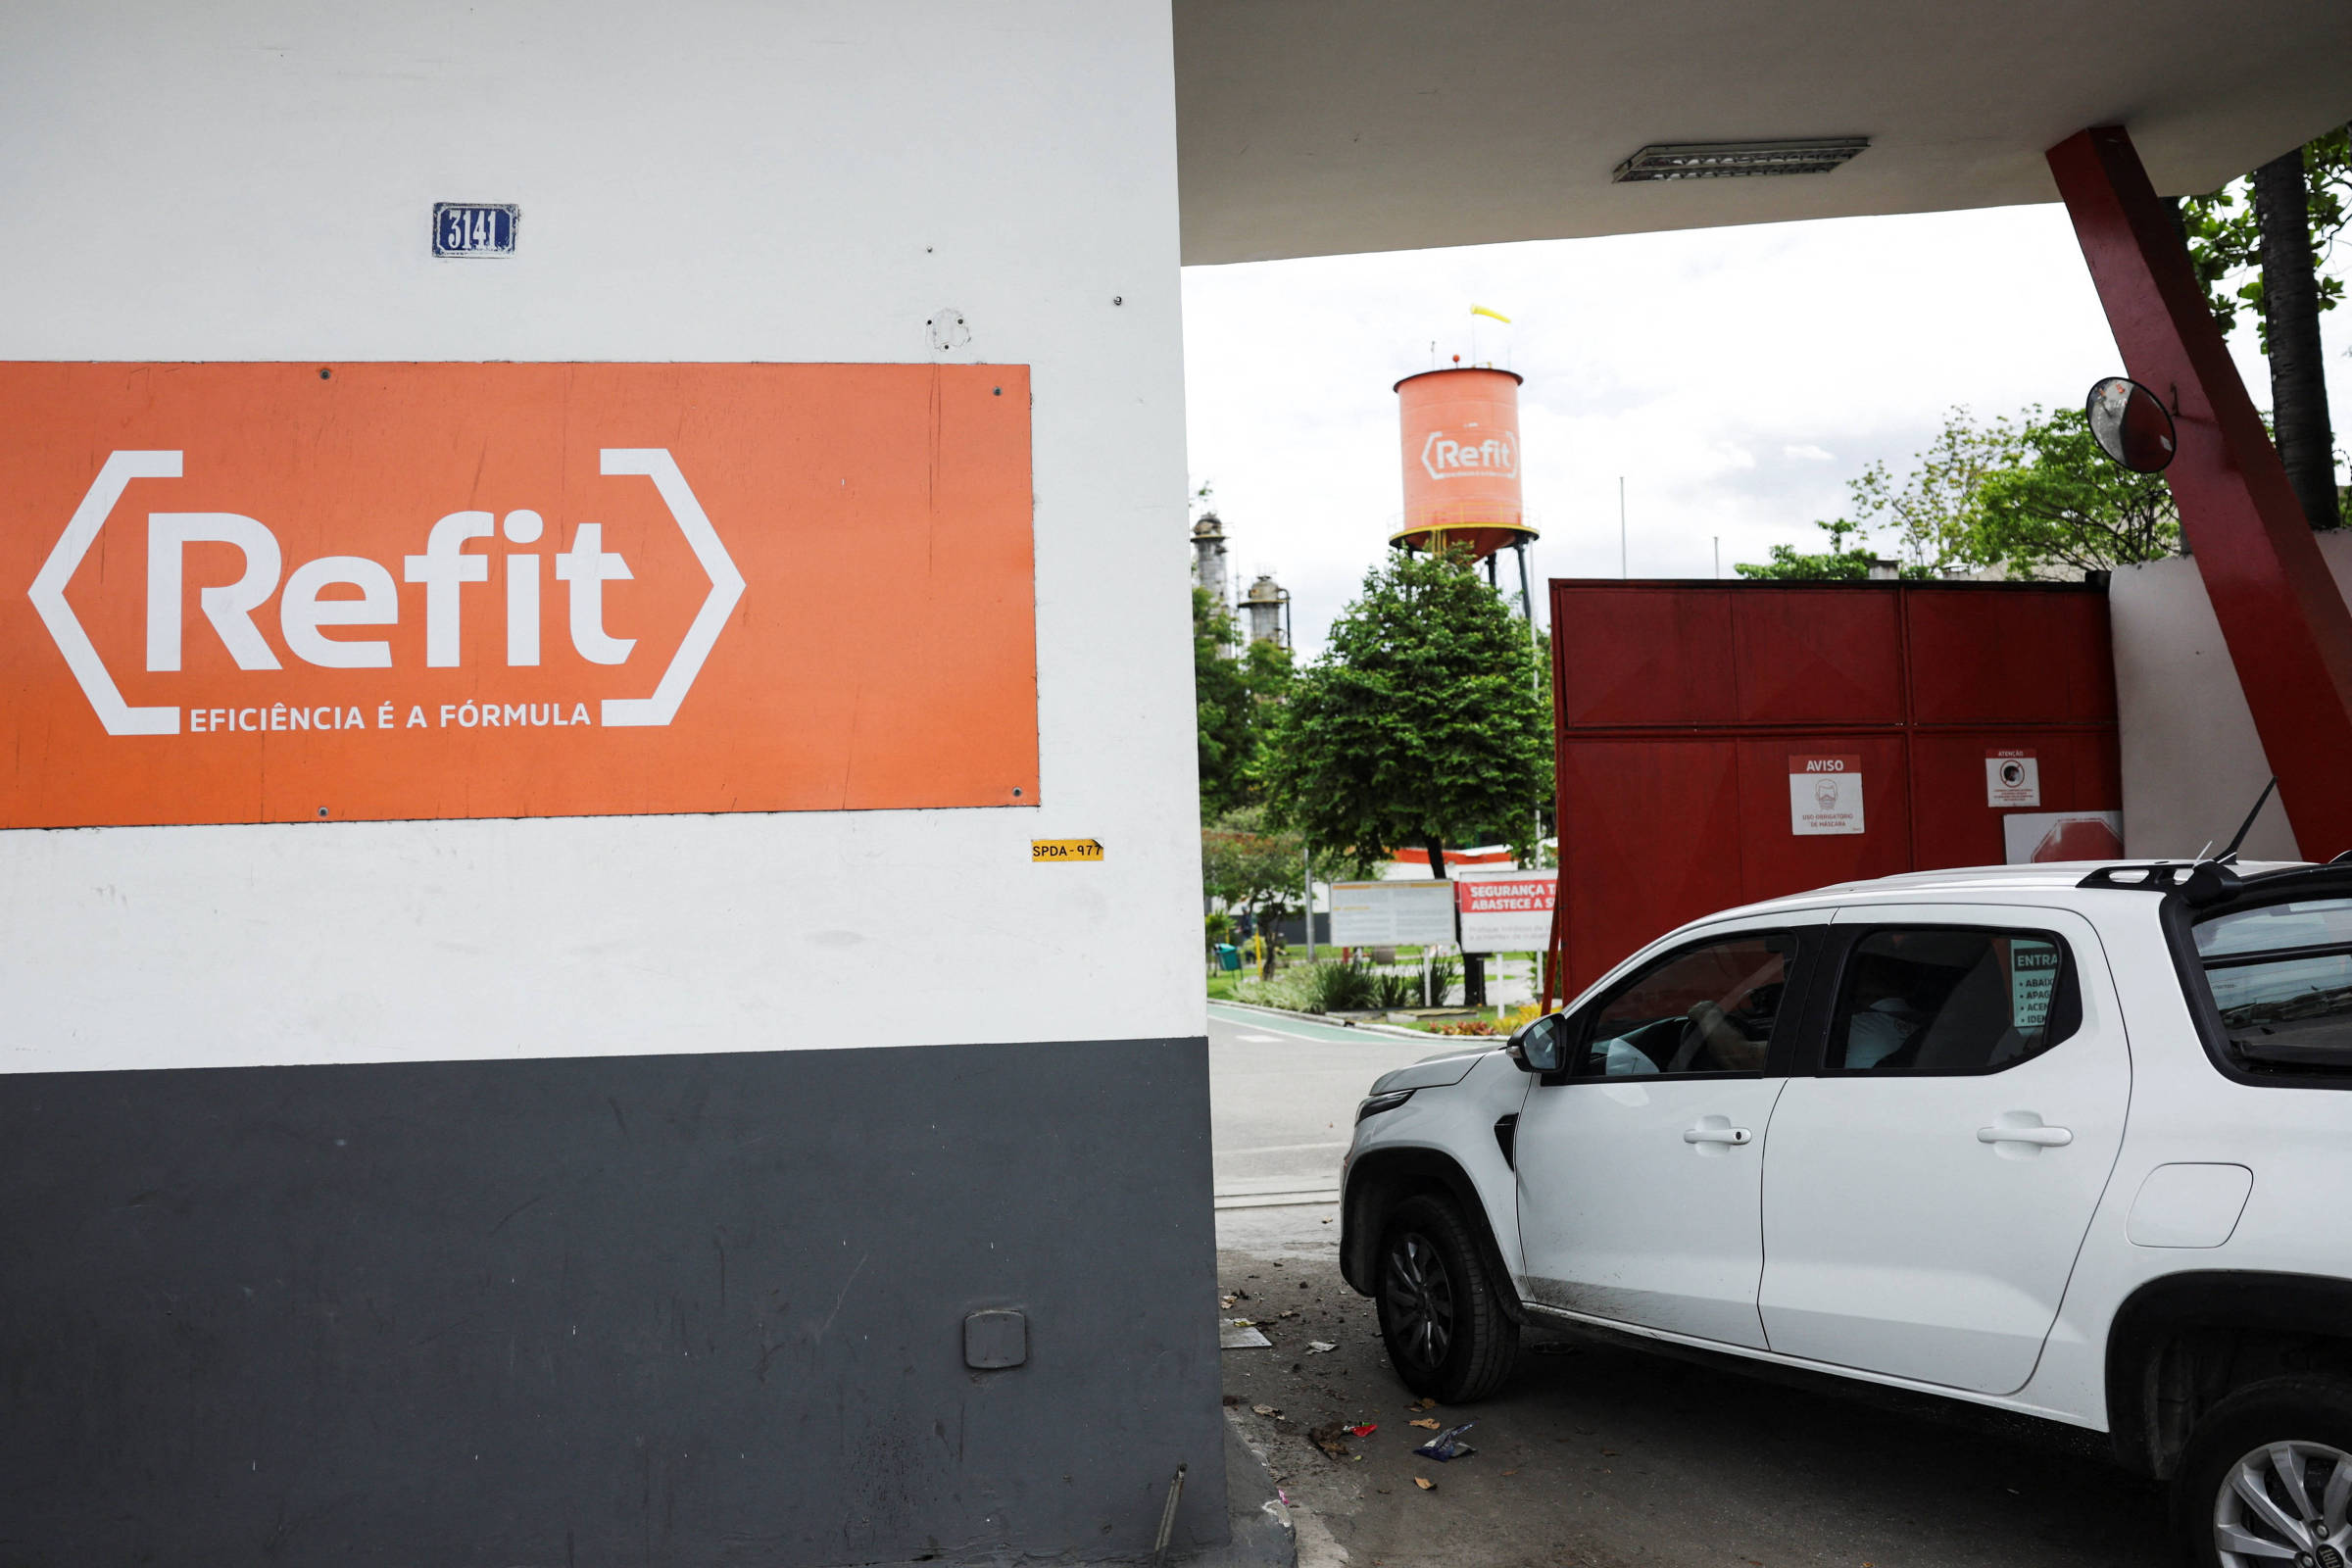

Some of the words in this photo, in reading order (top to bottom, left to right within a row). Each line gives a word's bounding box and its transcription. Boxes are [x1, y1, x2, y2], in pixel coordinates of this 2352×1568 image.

[448, 210, 497, 250] 3141
[1436, 439, 1511, 468] Refit
[147, 510, 637, 671] Refit
[190, 702, 366, 733] EFICIÊNCIA
[378, 701, 393, 728] É
[406, 705, 427, 728] A
[440, 699, 592, 728] FÓRMULA
[1806, 760, 1844, 772] AVISO
[1471, 884, 1544, 898] SEGURANÇA
[1472, 899, 1531, 909] ABASTECE
[1534, 898, 1544, 908] A
[2018, 955, 2057, 966] ENTRA
